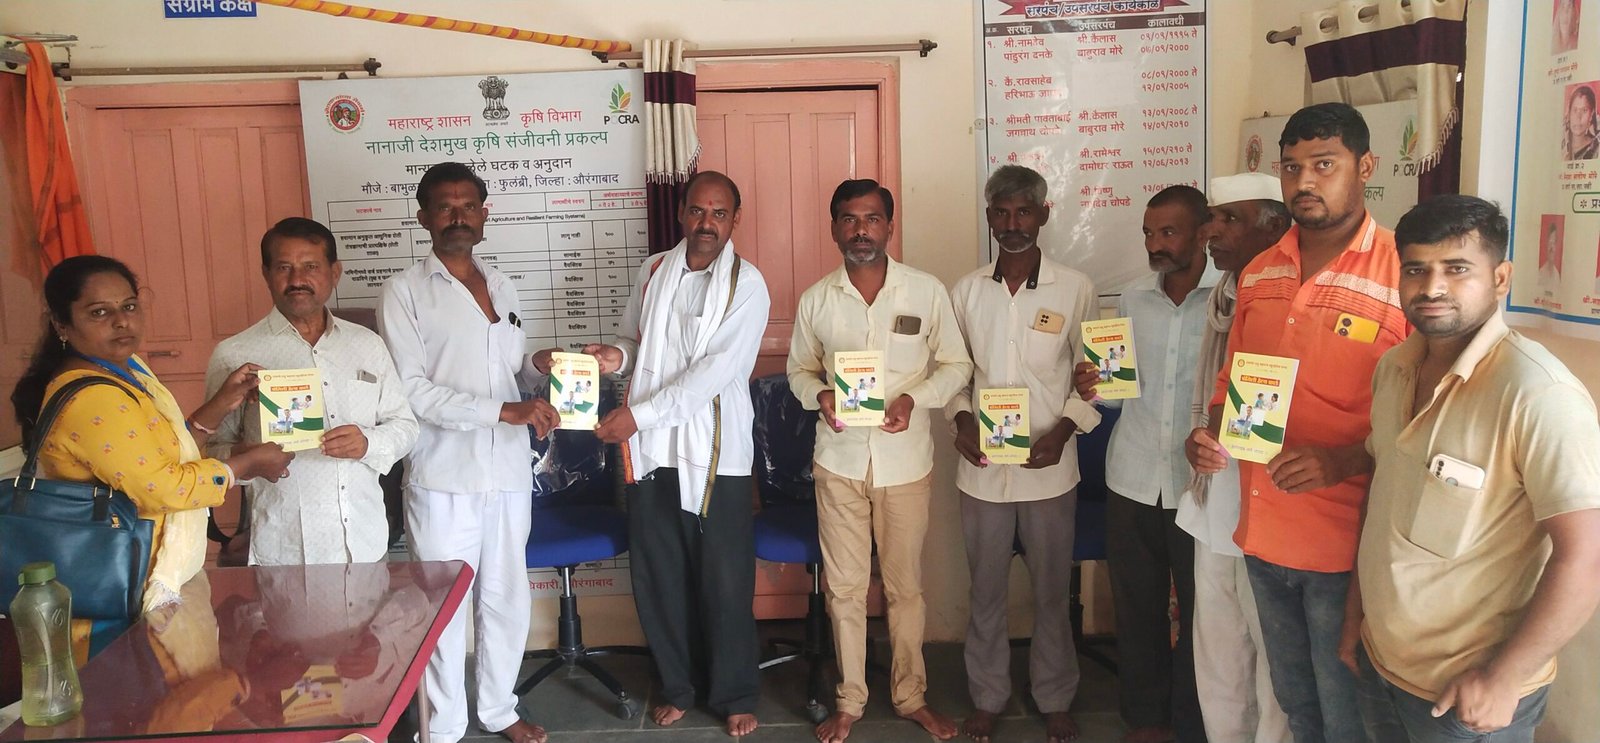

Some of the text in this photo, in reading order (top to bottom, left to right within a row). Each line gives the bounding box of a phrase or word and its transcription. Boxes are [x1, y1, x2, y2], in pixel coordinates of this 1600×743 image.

[1006, 23, 1033, 35] सरपंच
[1079, 19, 1117, 32] उपसरपंच
[1147, 15, 1185, 28] कालावधी
[388, 115, 471, 130] महाराष्ट्र शासन
[520, 108, 582, 128] कृषि विभाग
[603, 114, 640, 126] PCRA
[1110, 120, 1125, 132] मोरे
[365, 129, 608, 156] नानाजी देशमुख कृषि संजीवनी प्रकल्प
[490, 161, 519, 172] घटक
[522, 159, 531, 170] व
[533, 158, 572, 173] अनुदान
[361, 182, 382, 195] मौजे
[390, 183, 419, 196] बाभुळ
[535, 174, 565, 188] जिल्हा
[572, 173, 619, 186] औरंगाबाद
[1365, 186, 1385, 201] कल्प
[491, 215, 516, 223] Agriculture
